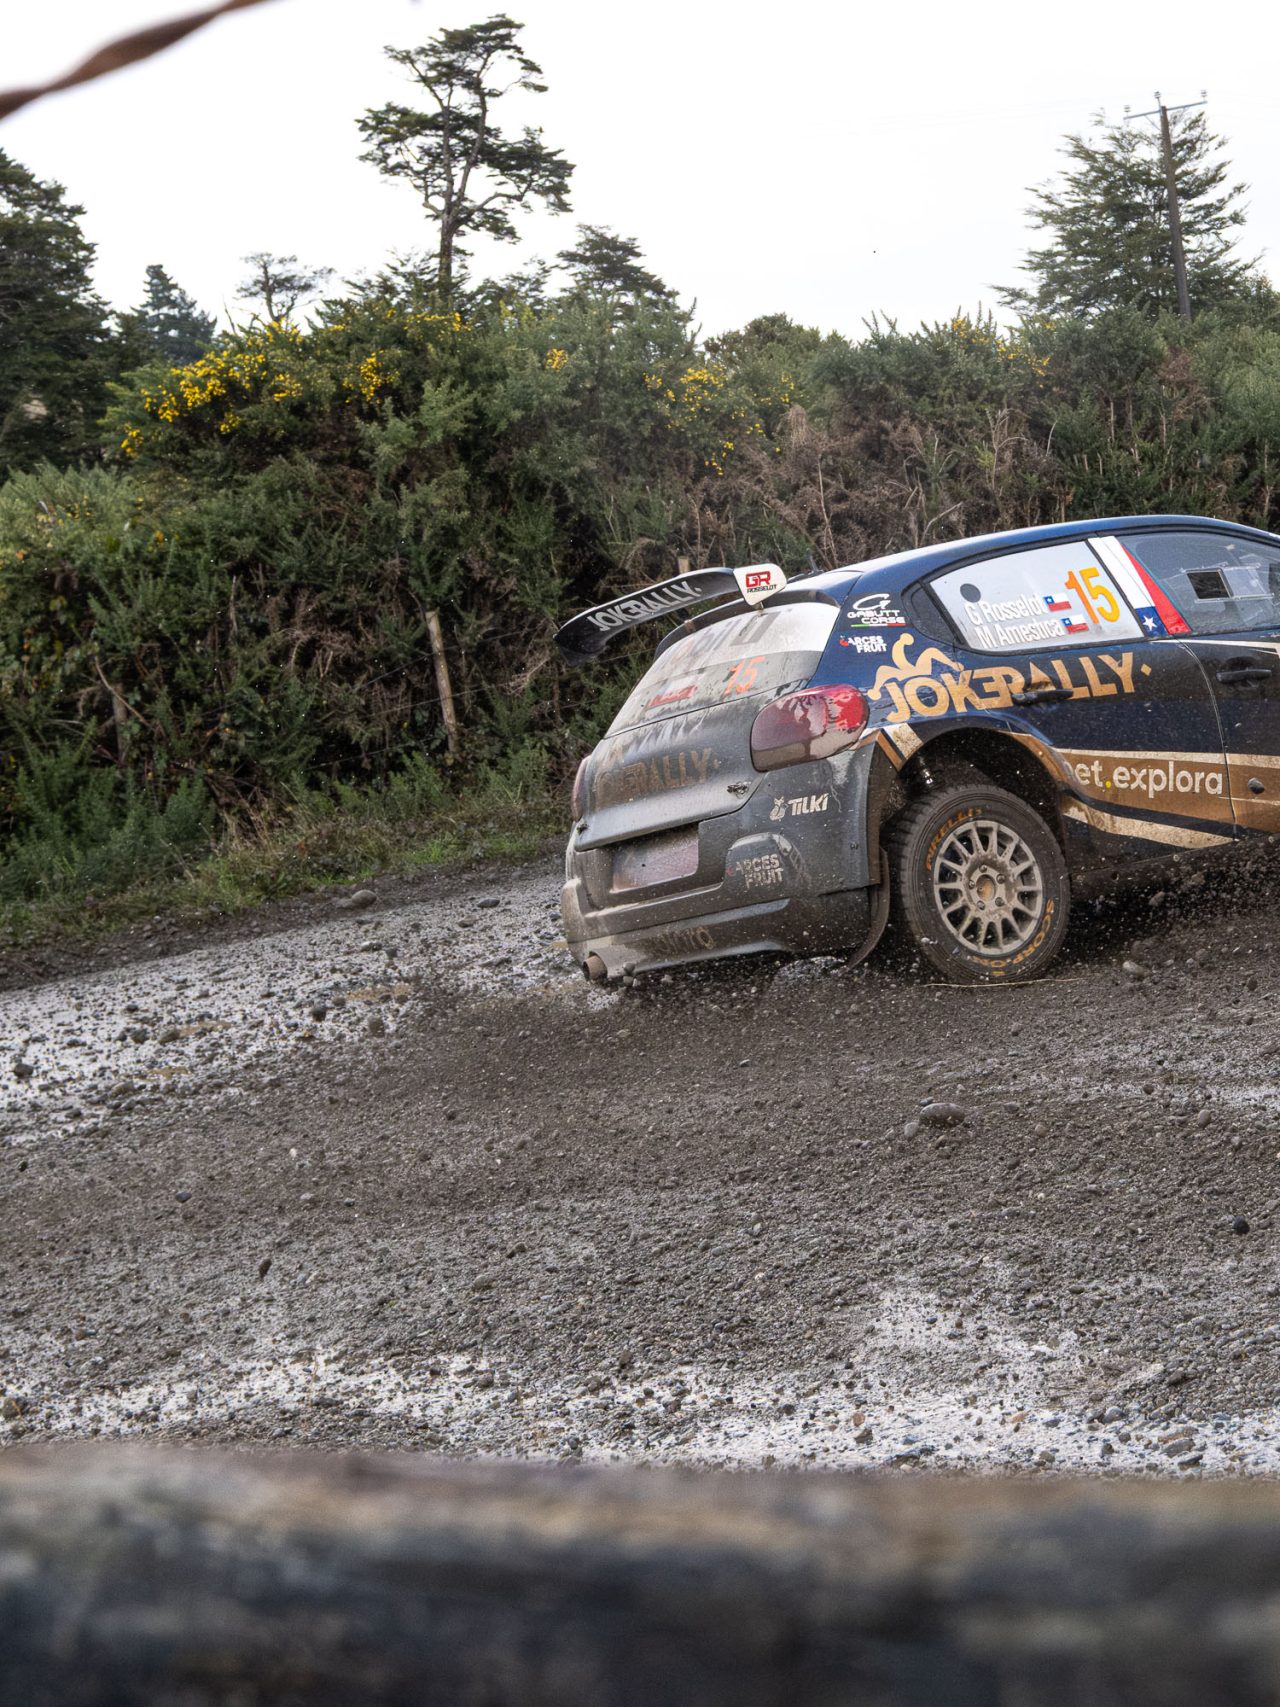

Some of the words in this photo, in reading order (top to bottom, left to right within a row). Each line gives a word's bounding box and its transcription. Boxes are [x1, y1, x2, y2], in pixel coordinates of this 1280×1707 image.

[746, 571, 771, 588] GR
[1064, 567, 1120, 624] 15
[861, 616, 906, 624] CORSE
[848, 636, 884, 646] ARCES
[975, 626, 999, 650] M
[856, 642, 887, 653] FRUIT
[723, 656, 766, 696] 15
